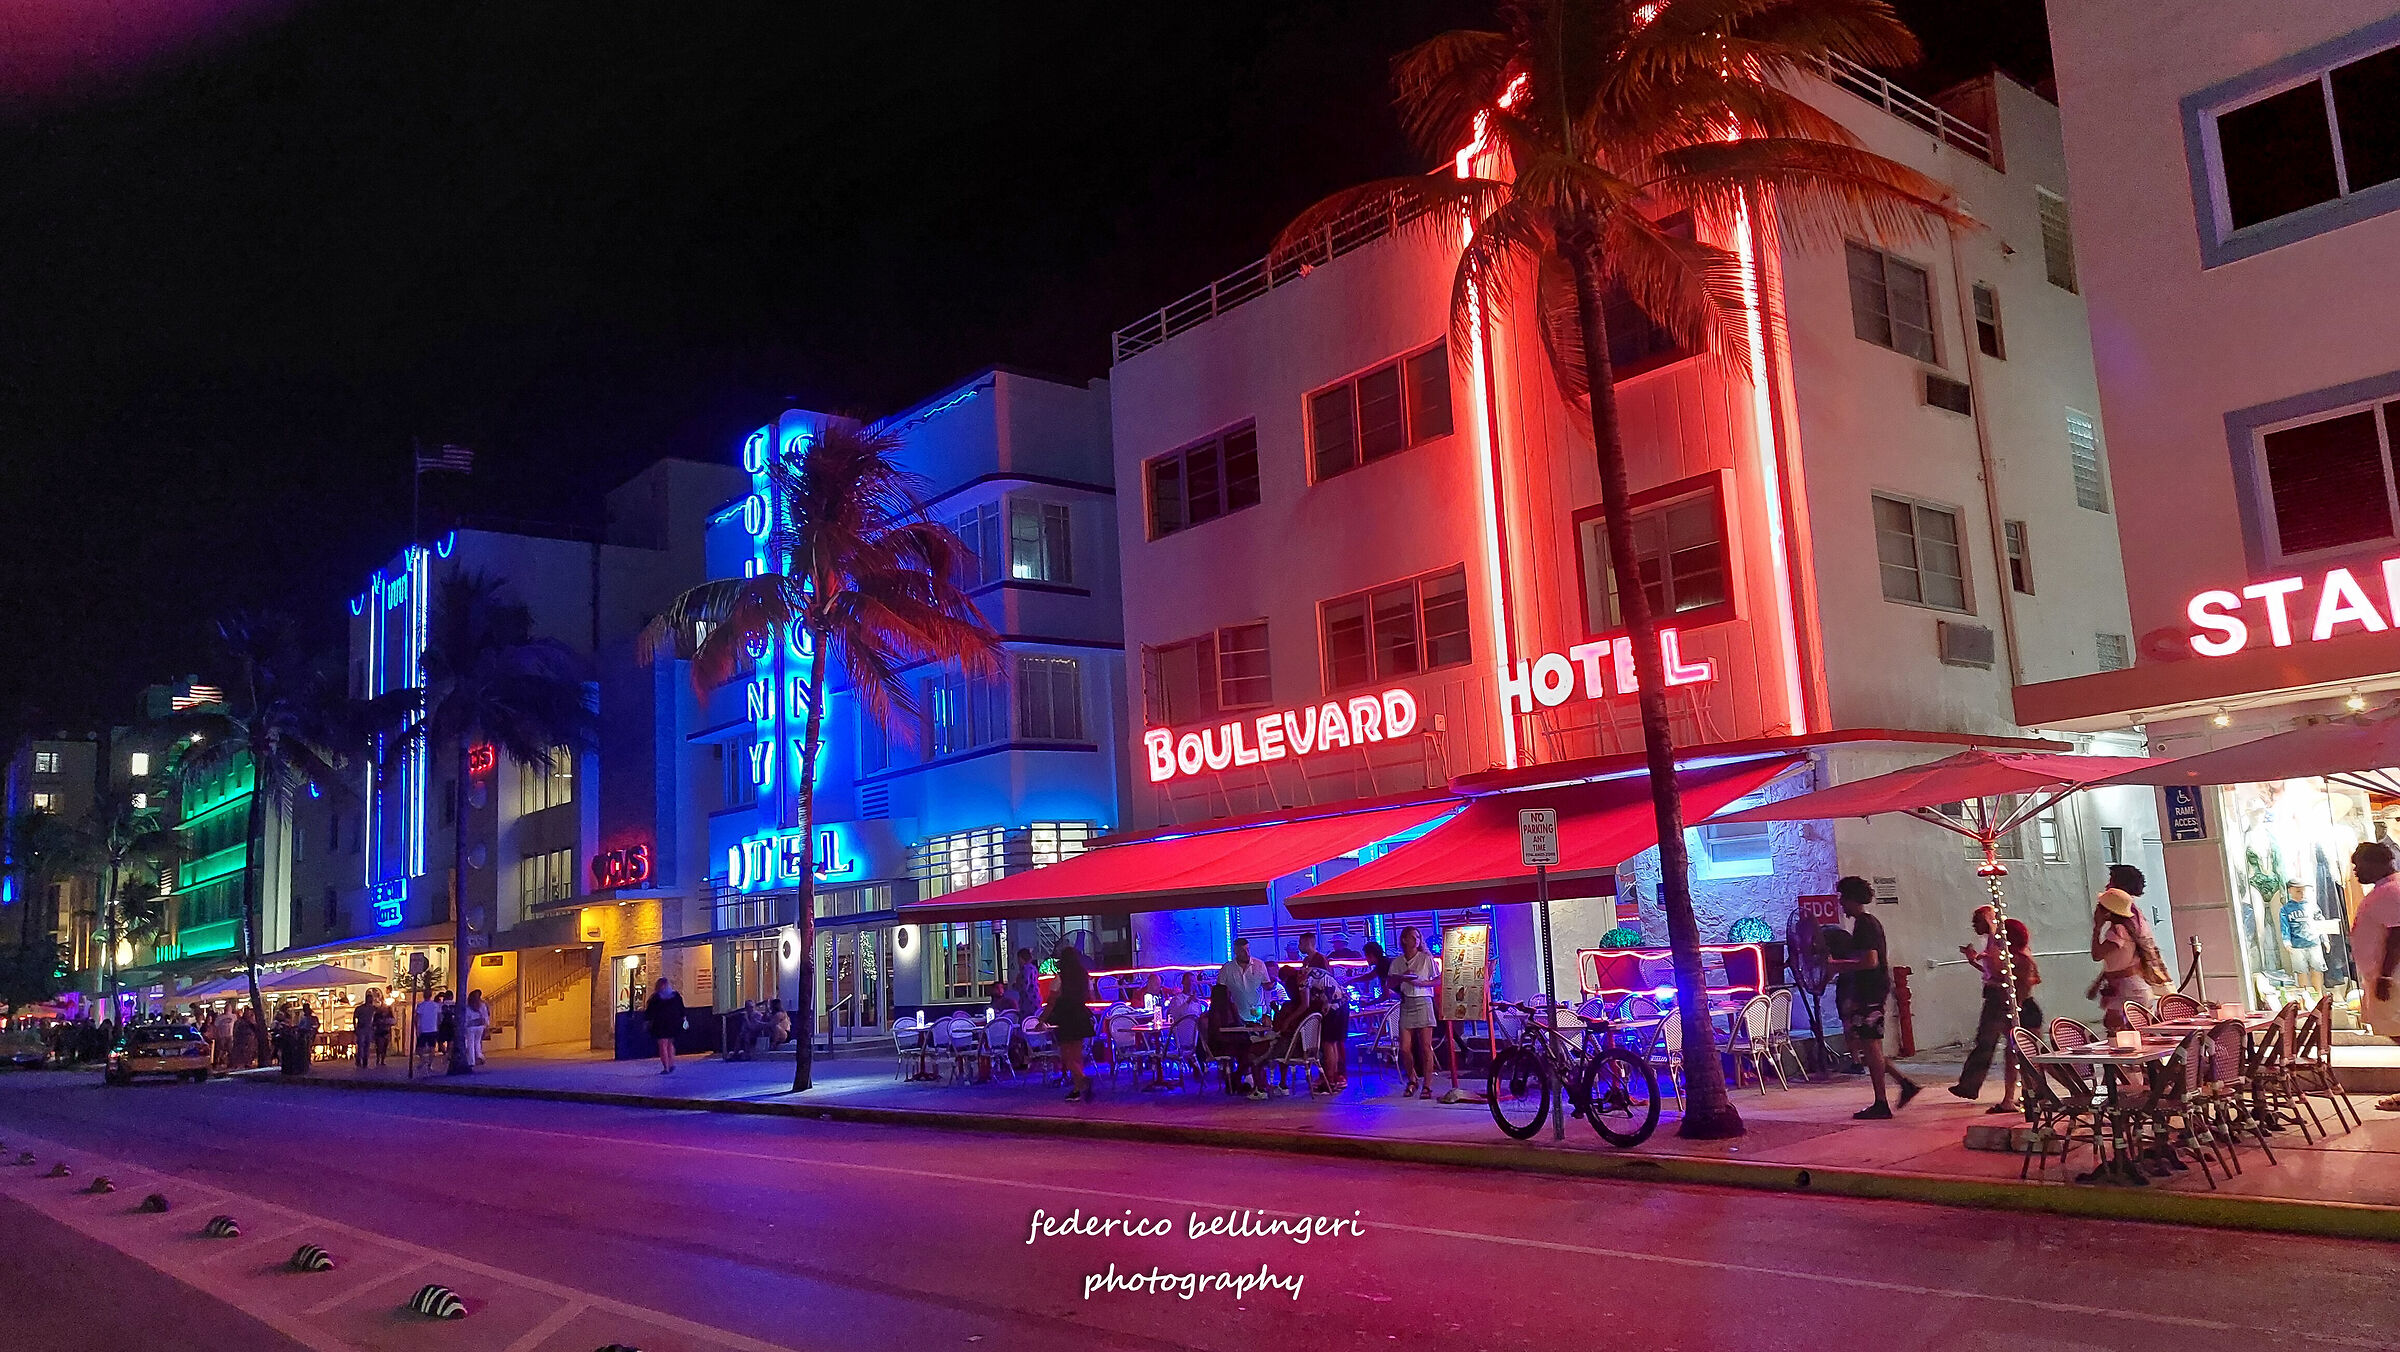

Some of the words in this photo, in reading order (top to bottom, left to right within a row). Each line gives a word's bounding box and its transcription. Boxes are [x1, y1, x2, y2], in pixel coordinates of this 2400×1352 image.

[1144, 688, 1417, 782] BOULEVARD
[1498, 628, 1712, 713] HOTEL
[1531, 813, 1544, 823] NO
[2174, 818, 2198, 827] ACCES
[1523, 824, 1554, 834] PARKING
[1803, 901, 1834, 918] FDC
